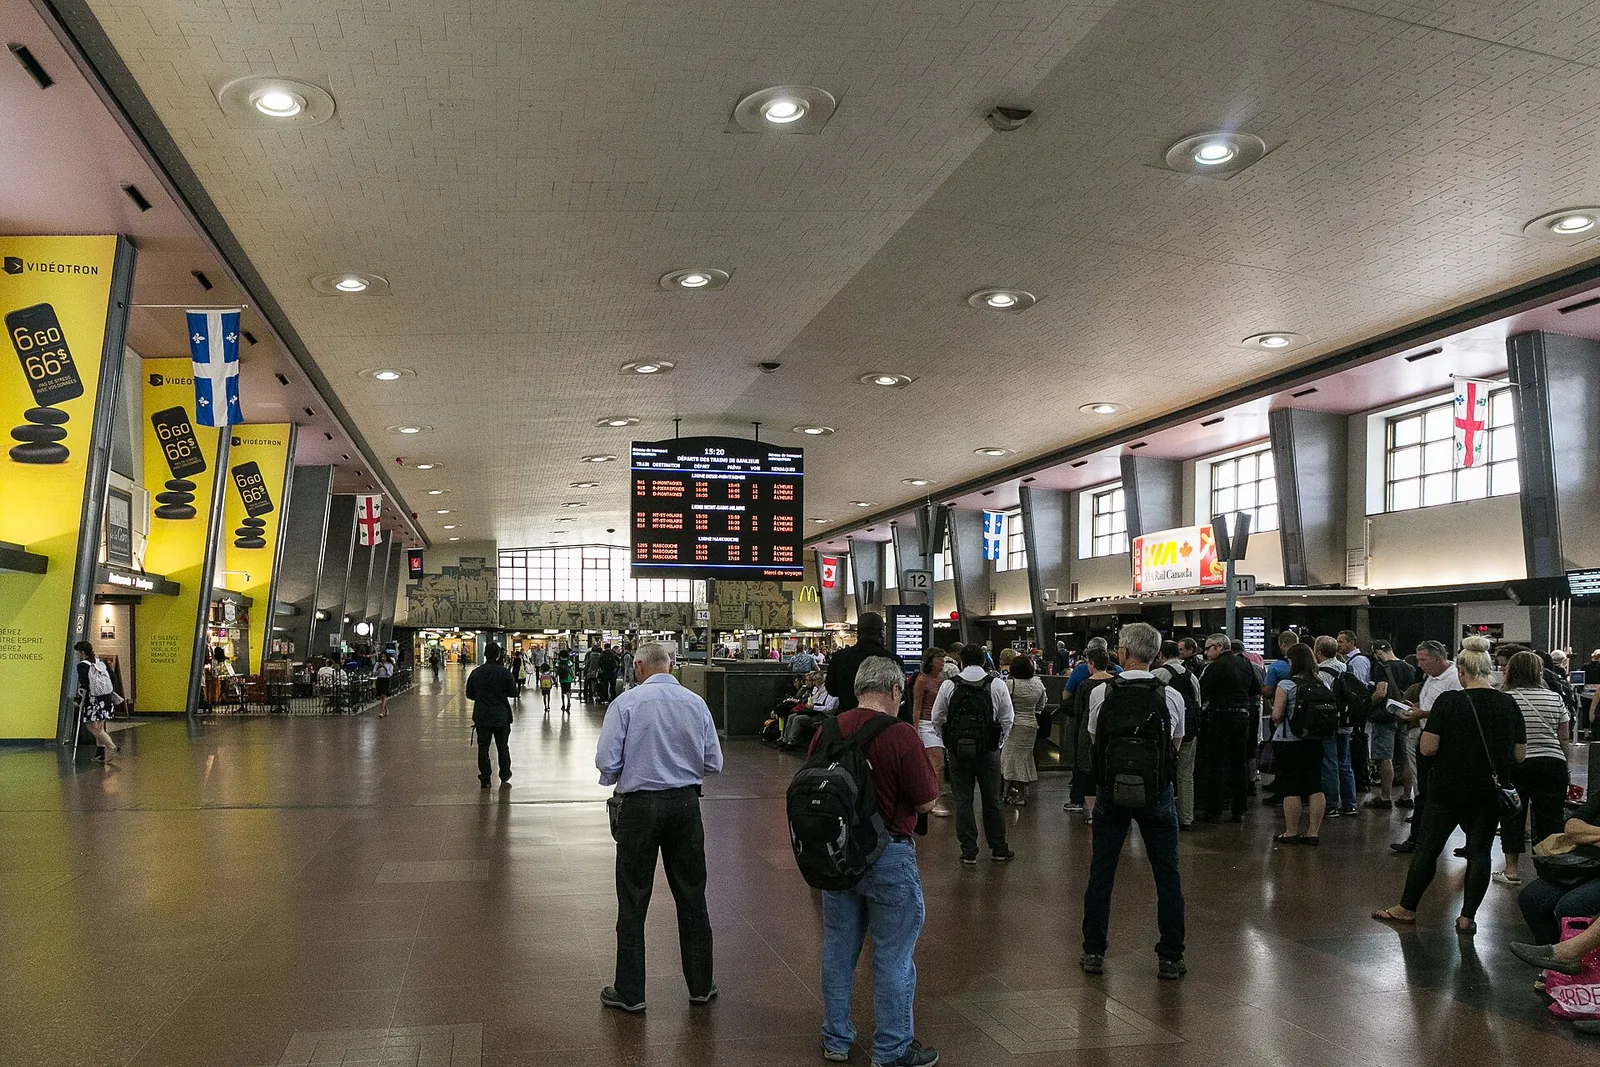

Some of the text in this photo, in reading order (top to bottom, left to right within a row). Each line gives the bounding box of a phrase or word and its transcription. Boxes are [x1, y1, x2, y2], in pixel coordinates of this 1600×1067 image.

[27, 262, 98, 274] VIDÉOTRON
[166, 378, 196, 386] VIDÉO
[1144, 541, 1176, 568] VIA
[1155, 570, 1166, 580] Rail
[1166, 568, 1192, 580] Canada
[910, 575, 926, 587] 12
[1236, 579, 1248, 591] 11
